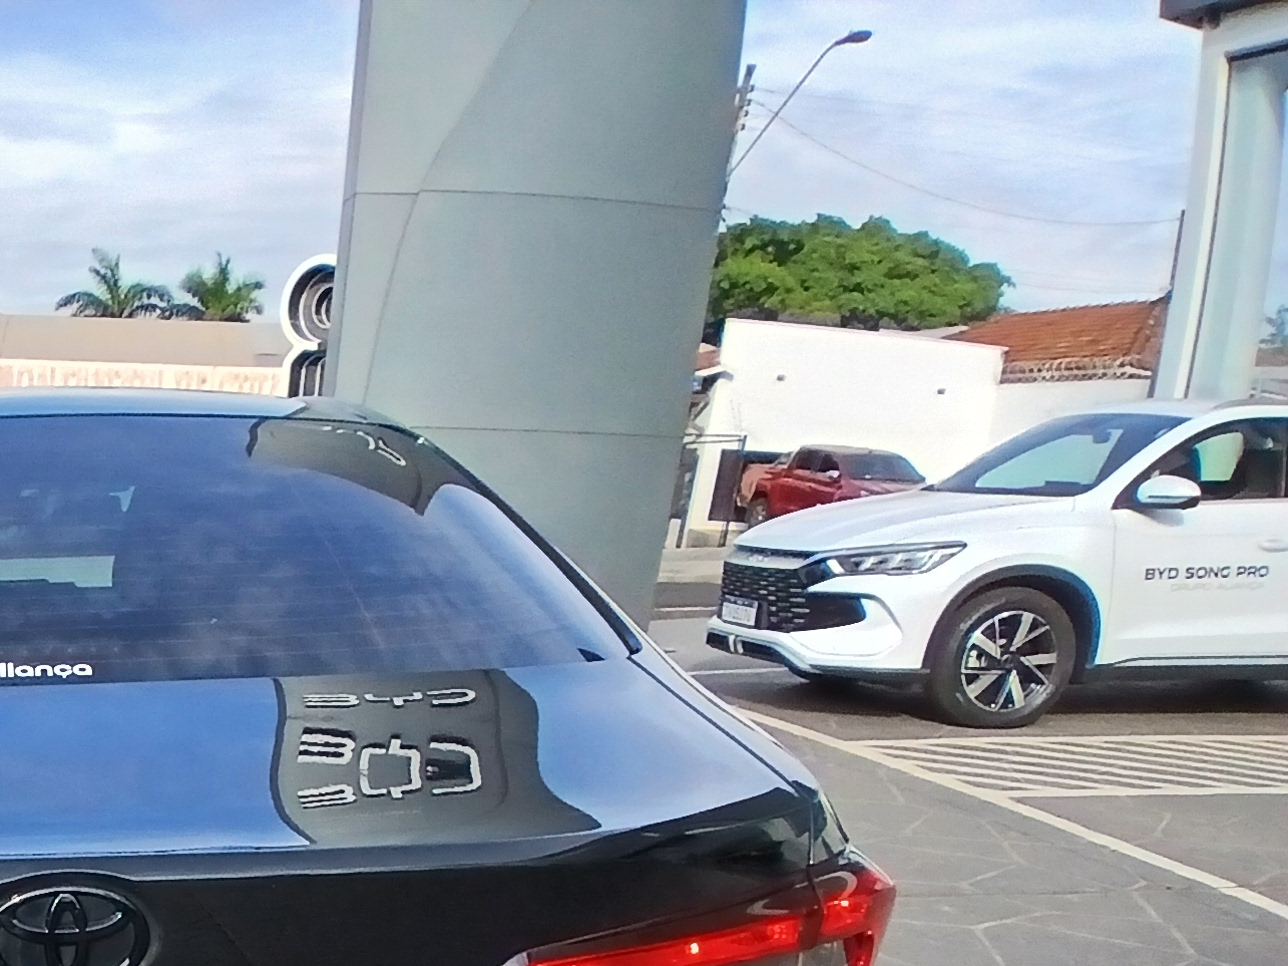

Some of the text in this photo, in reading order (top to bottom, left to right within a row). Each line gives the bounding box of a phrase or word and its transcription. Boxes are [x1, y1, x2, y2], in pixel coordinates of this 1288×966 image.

[1144, 565, 1270, 581] BYD SONG PRO
